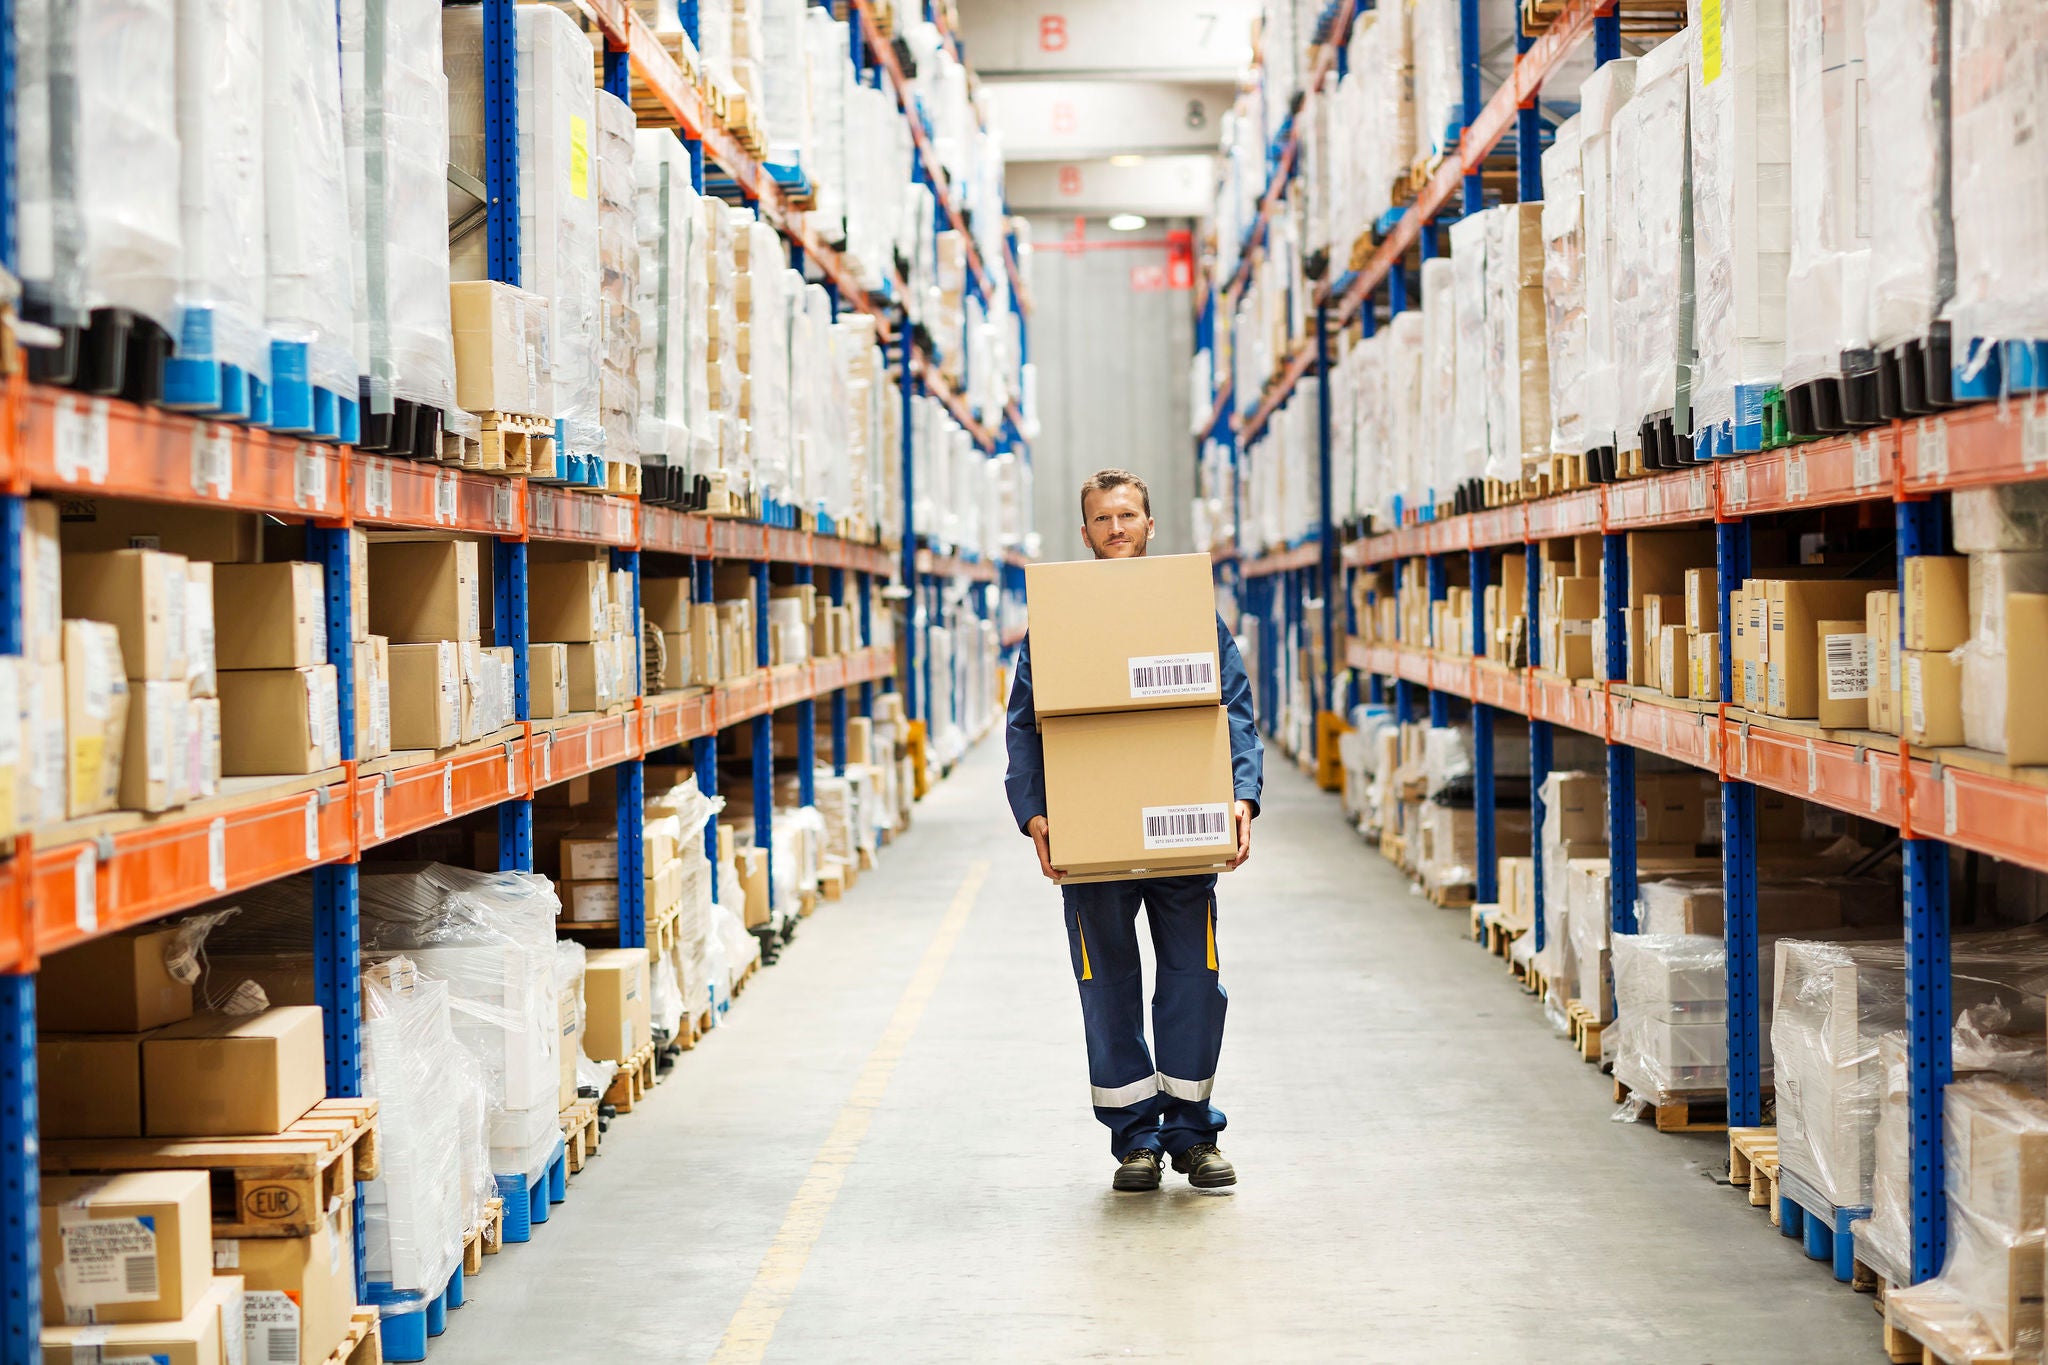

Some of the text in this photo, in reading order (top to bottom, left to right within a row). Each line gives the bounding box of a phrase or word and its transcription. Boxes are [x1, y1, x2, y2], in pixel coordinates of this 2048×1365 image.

[1039, 14, 1068, 53] B
[1195, 14, 1218, 48] 7
[1053, 102, 1077, 133] B
[1185, 99, 1206, 130] 8
[1058, 163, 1082, 196] B
[255, 1191, 290, 1214] EUR
